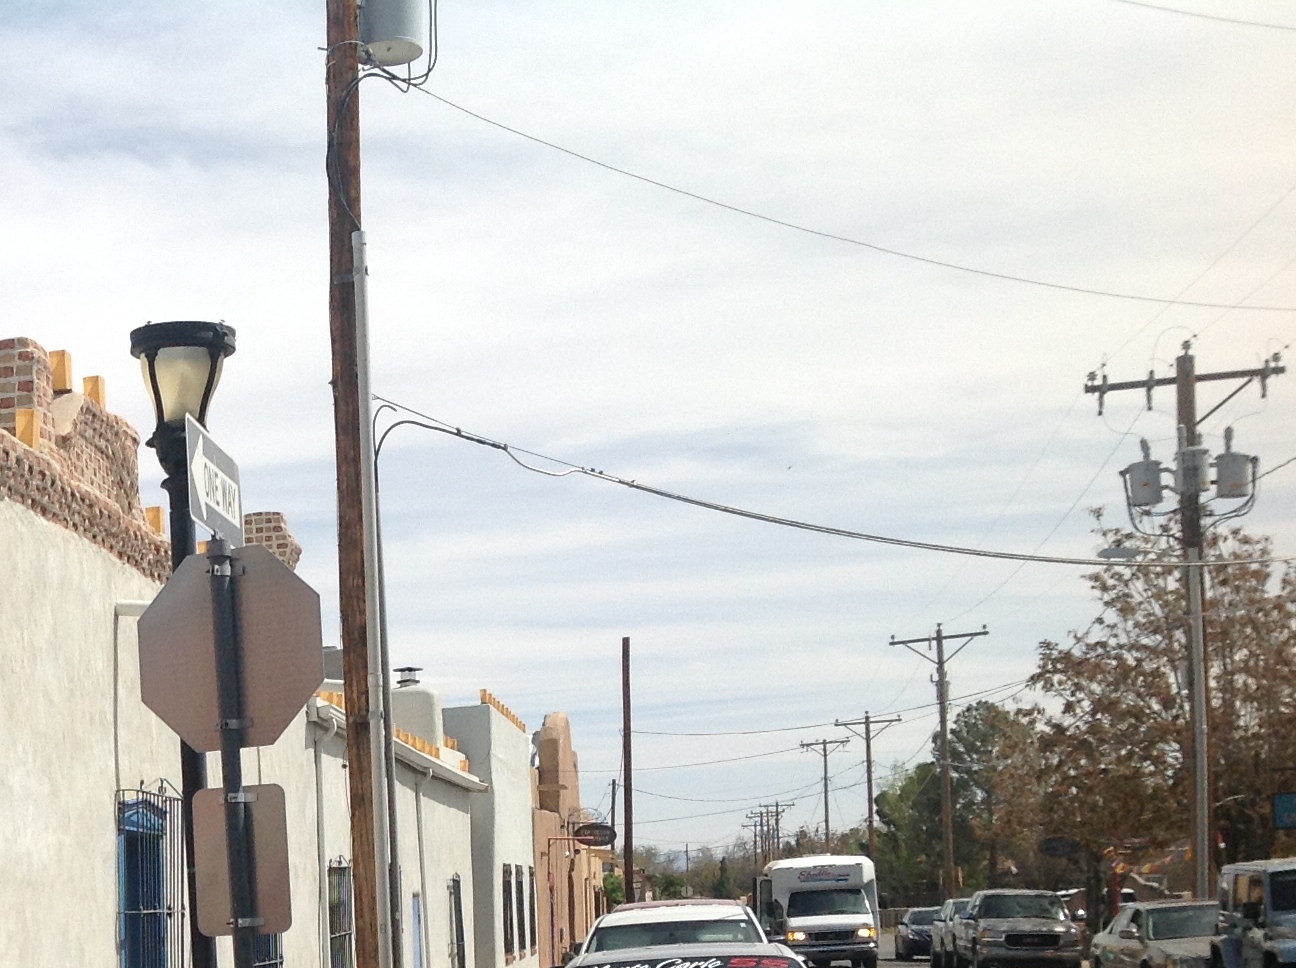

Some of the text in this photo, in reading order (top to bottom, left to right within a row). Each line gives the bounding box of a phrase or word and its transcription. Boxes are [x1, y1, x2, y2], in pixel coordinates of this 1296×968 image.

[204, 462, 236, 520] ONE WAY
[727, 957, 790, 968] SS
